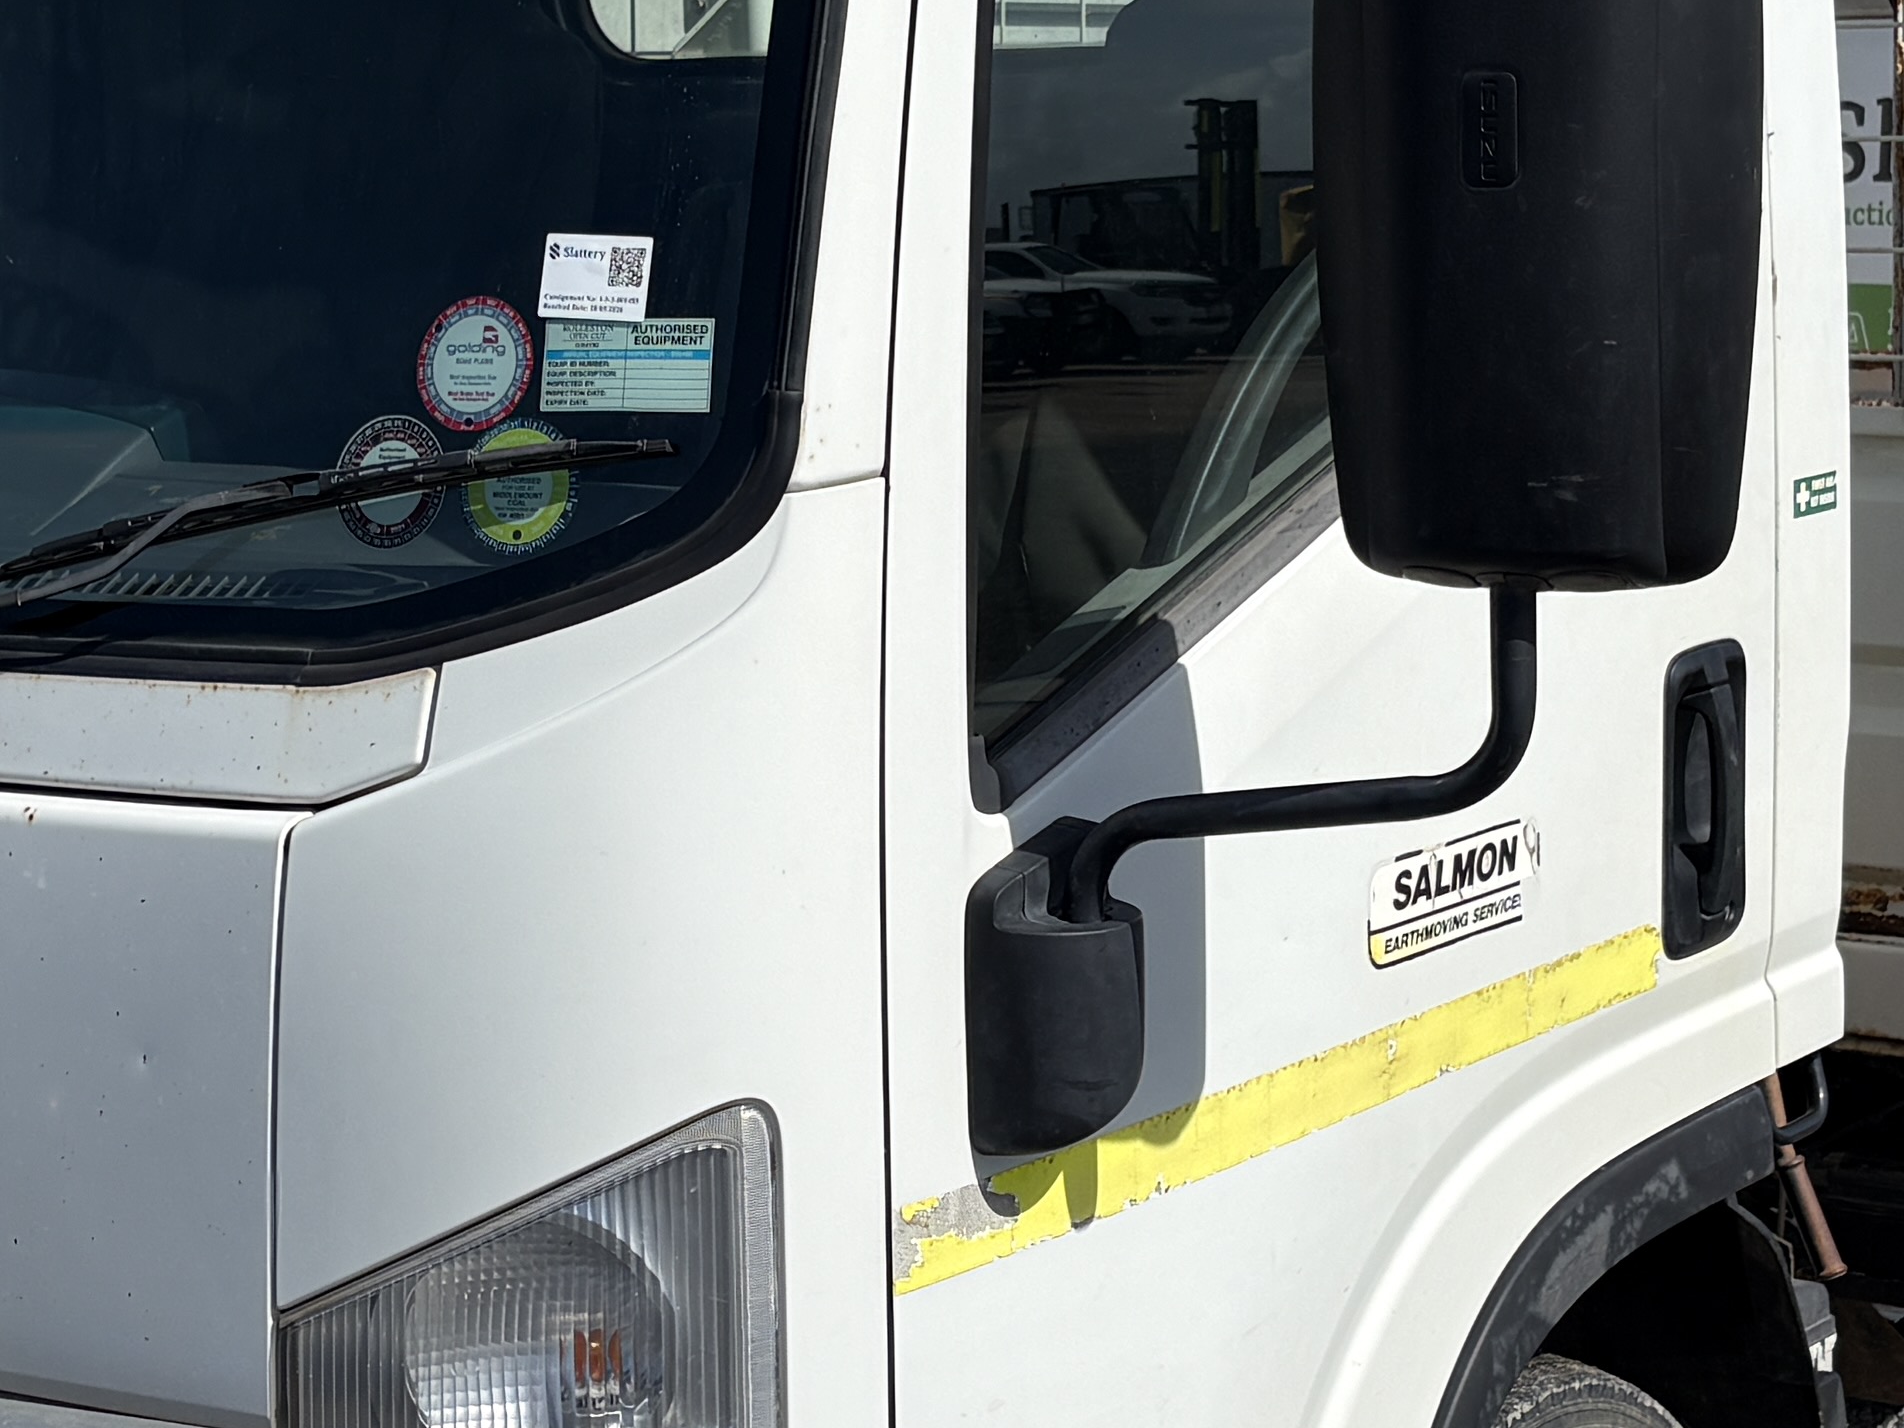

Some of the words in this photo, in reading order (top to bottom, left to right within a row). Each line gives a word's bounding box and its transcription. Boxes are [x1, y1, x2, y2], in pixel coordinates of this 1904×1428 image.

[1479, 80, 1498, 182] ISUZU
[563, 246, 607, 262] Slattery
[630, 323, 710, 335] AUTHORISED
[634, 335, 706, 346] EQUIPMENT
[446, 342, 507, 357] golding
[1392, 835, 1519, 911] SALMON
[1384, 910, 1469, 955] EARTHMOVING
[1472, 892, 1522, 924] SERVICE
